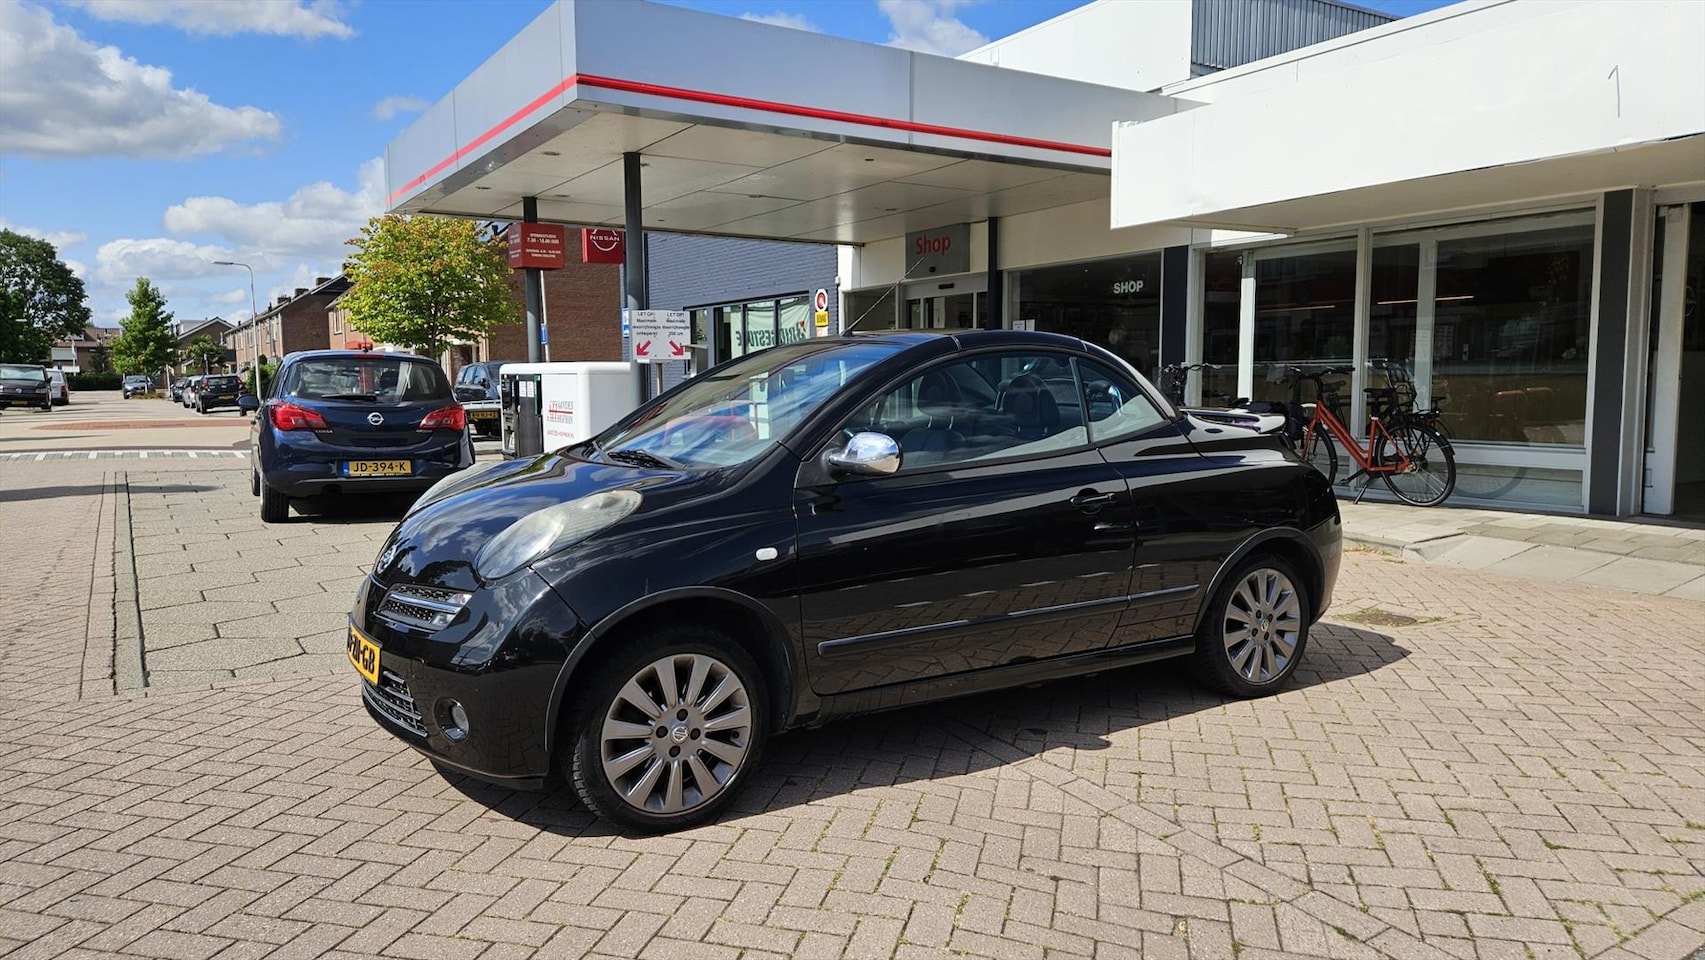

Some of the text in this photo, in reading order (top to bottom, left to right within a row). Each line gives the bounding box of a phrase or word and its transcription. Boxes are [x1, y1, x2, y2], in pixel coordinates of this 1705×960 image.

[590, 234, 620, 242] NISSAN
[916, 234, 951, 256] Shop
[1113, 280, 1144, 294] SHOP
[353, 461, 406, 473] JD-394-K
